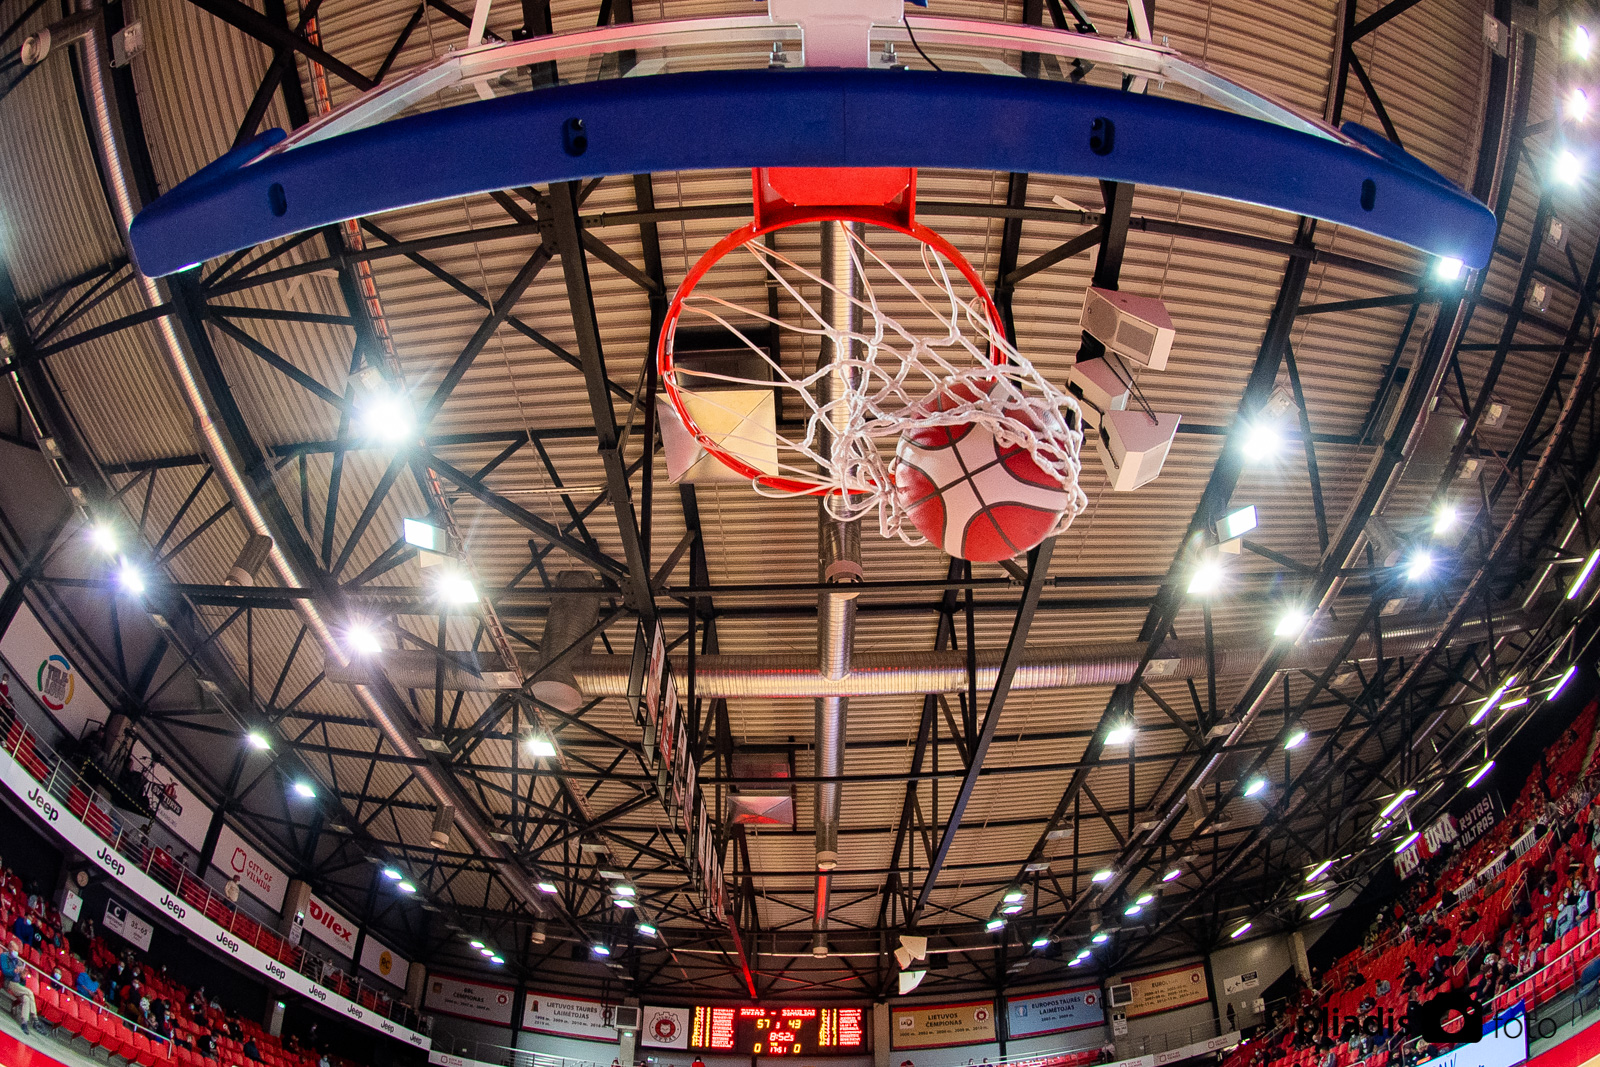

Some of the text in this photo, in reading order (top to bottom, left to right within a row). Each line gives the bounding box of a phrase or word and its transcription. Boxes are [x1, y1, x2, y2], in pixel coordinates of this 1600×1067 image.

[27, 788, 59, 822] Jeep
[1459, 796, 1490, 831] RYTAS
[1461, 811, 1494, 847] ULTRAS
[97, 847, 125, 876] Jeep
[248, 860, 273, 882] CITY OF
[247, 869, 271, 893] VILNIUS
[113, 906, 122, 918] C
[160, 894, 186, 919] Jeep
[216, 931, 239, 953] Jeep
[265, 961, 286, 980] Jeep
[309, 984, 327, 1001] Jeep
[546, 1002, 598, 1015] LIETUVOS TAURĖS
[1031, 996, 1081, 1010] EUROPOS TAURĖS
[1039, 1005, 1075, 1016] LAIMĖTOJAS
[347, 1004, 363, 1020] Jeep
[553, 1010, 590, 1020] LAIMĖTOJAS
[927, 1013, 958, 1021] LIETUVOS
[380, 1020, 394, 1034] Jeep
[756, 1018, 802, 1029] 57 3 43
[925, 1020, 962, 1028] ČEMPIONAS
[409, 1033, 423, 1046] Jeep
[753, 1042, 762, 1053] 0
[793, 1043, 802, 1054] 0
